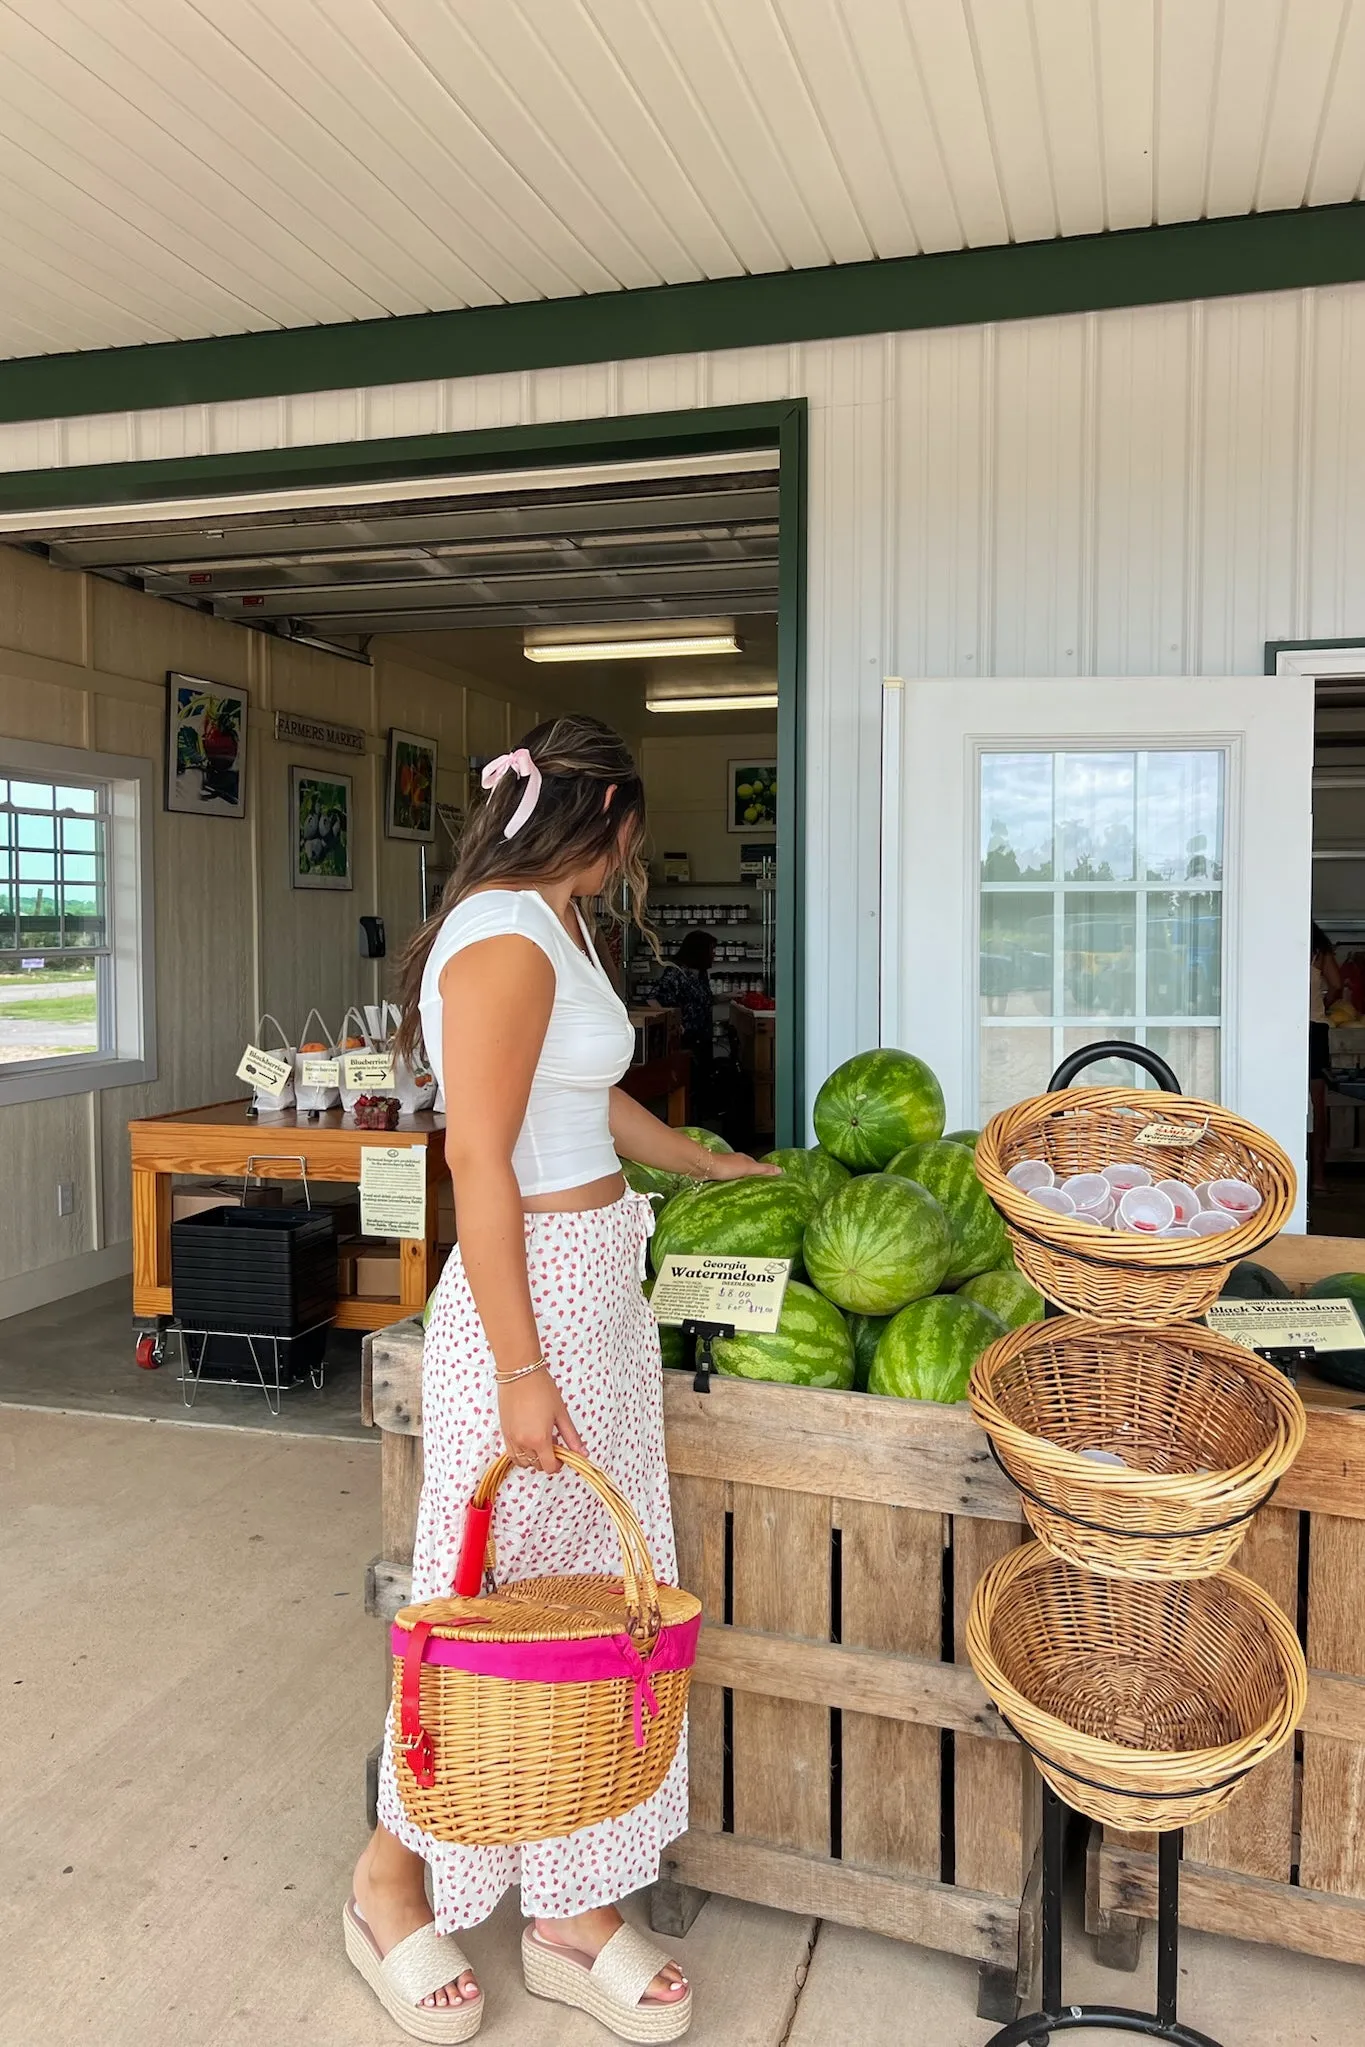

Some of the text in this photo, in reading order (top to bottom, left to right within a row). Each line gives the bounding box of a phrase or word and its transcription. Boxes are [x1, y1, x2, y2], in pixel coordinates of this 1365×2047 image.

[279, 718, 364, 750] FARMERS MARKET
[249, 1050, 286, 1074] Blackberries
[703, 1260, 747, 1270] Georgia
[671, 1267, 775, 1283] Watermelons
[1251, 1304, 1347, 1313] Watermelons
